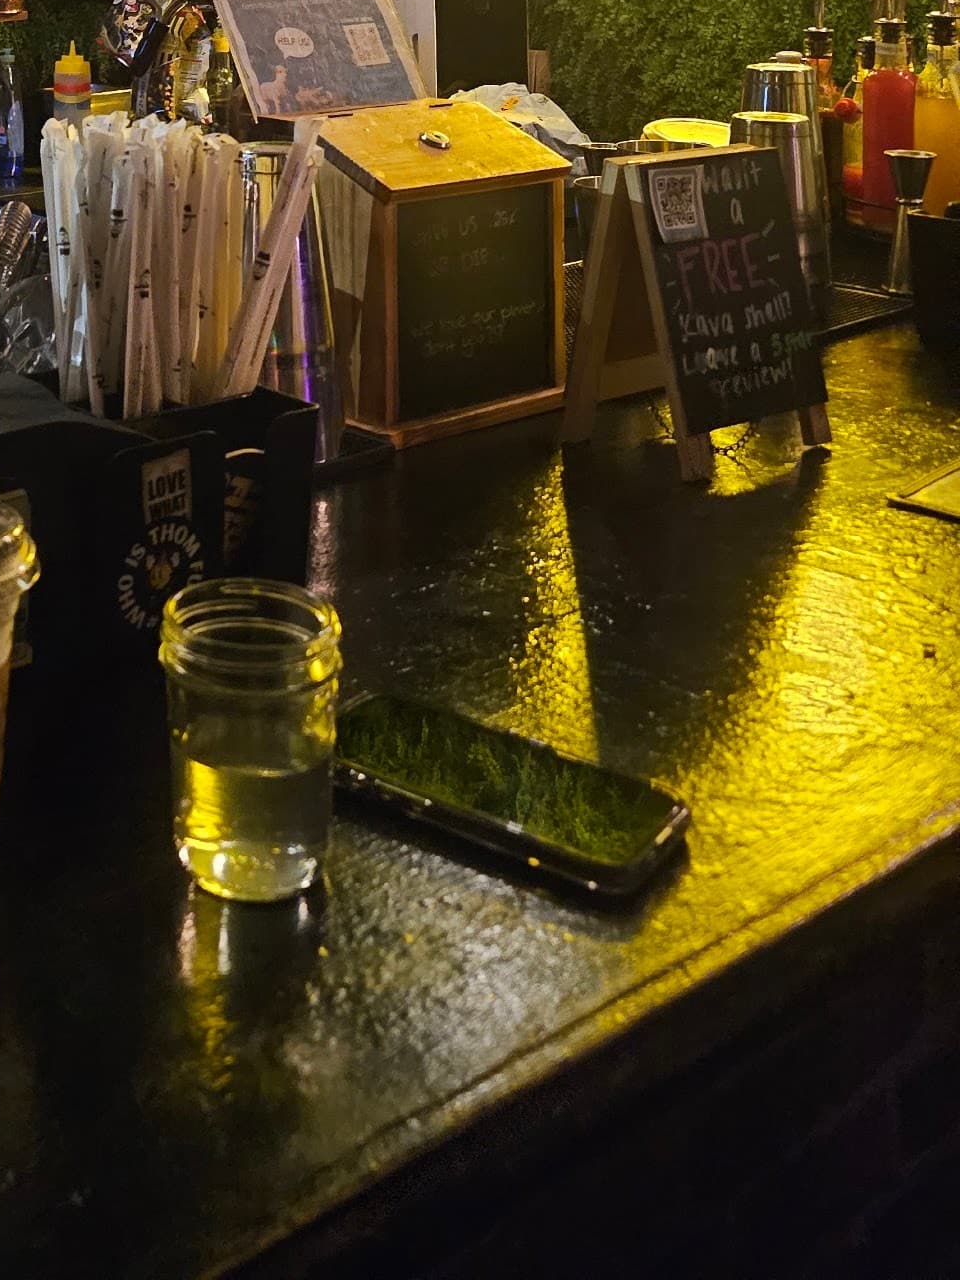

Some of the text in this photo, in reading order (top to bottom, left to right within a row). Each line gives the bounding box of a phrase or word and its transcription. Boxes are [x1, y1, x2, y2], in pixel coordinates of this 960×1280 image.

[676, 231, 768, 312] FREE
[679, 311, 735, 343] Kava
[147, 469, 186, 498] LOVE
[124, 541, 147, 569] IS
[146, 521, 203, 559] THOM
